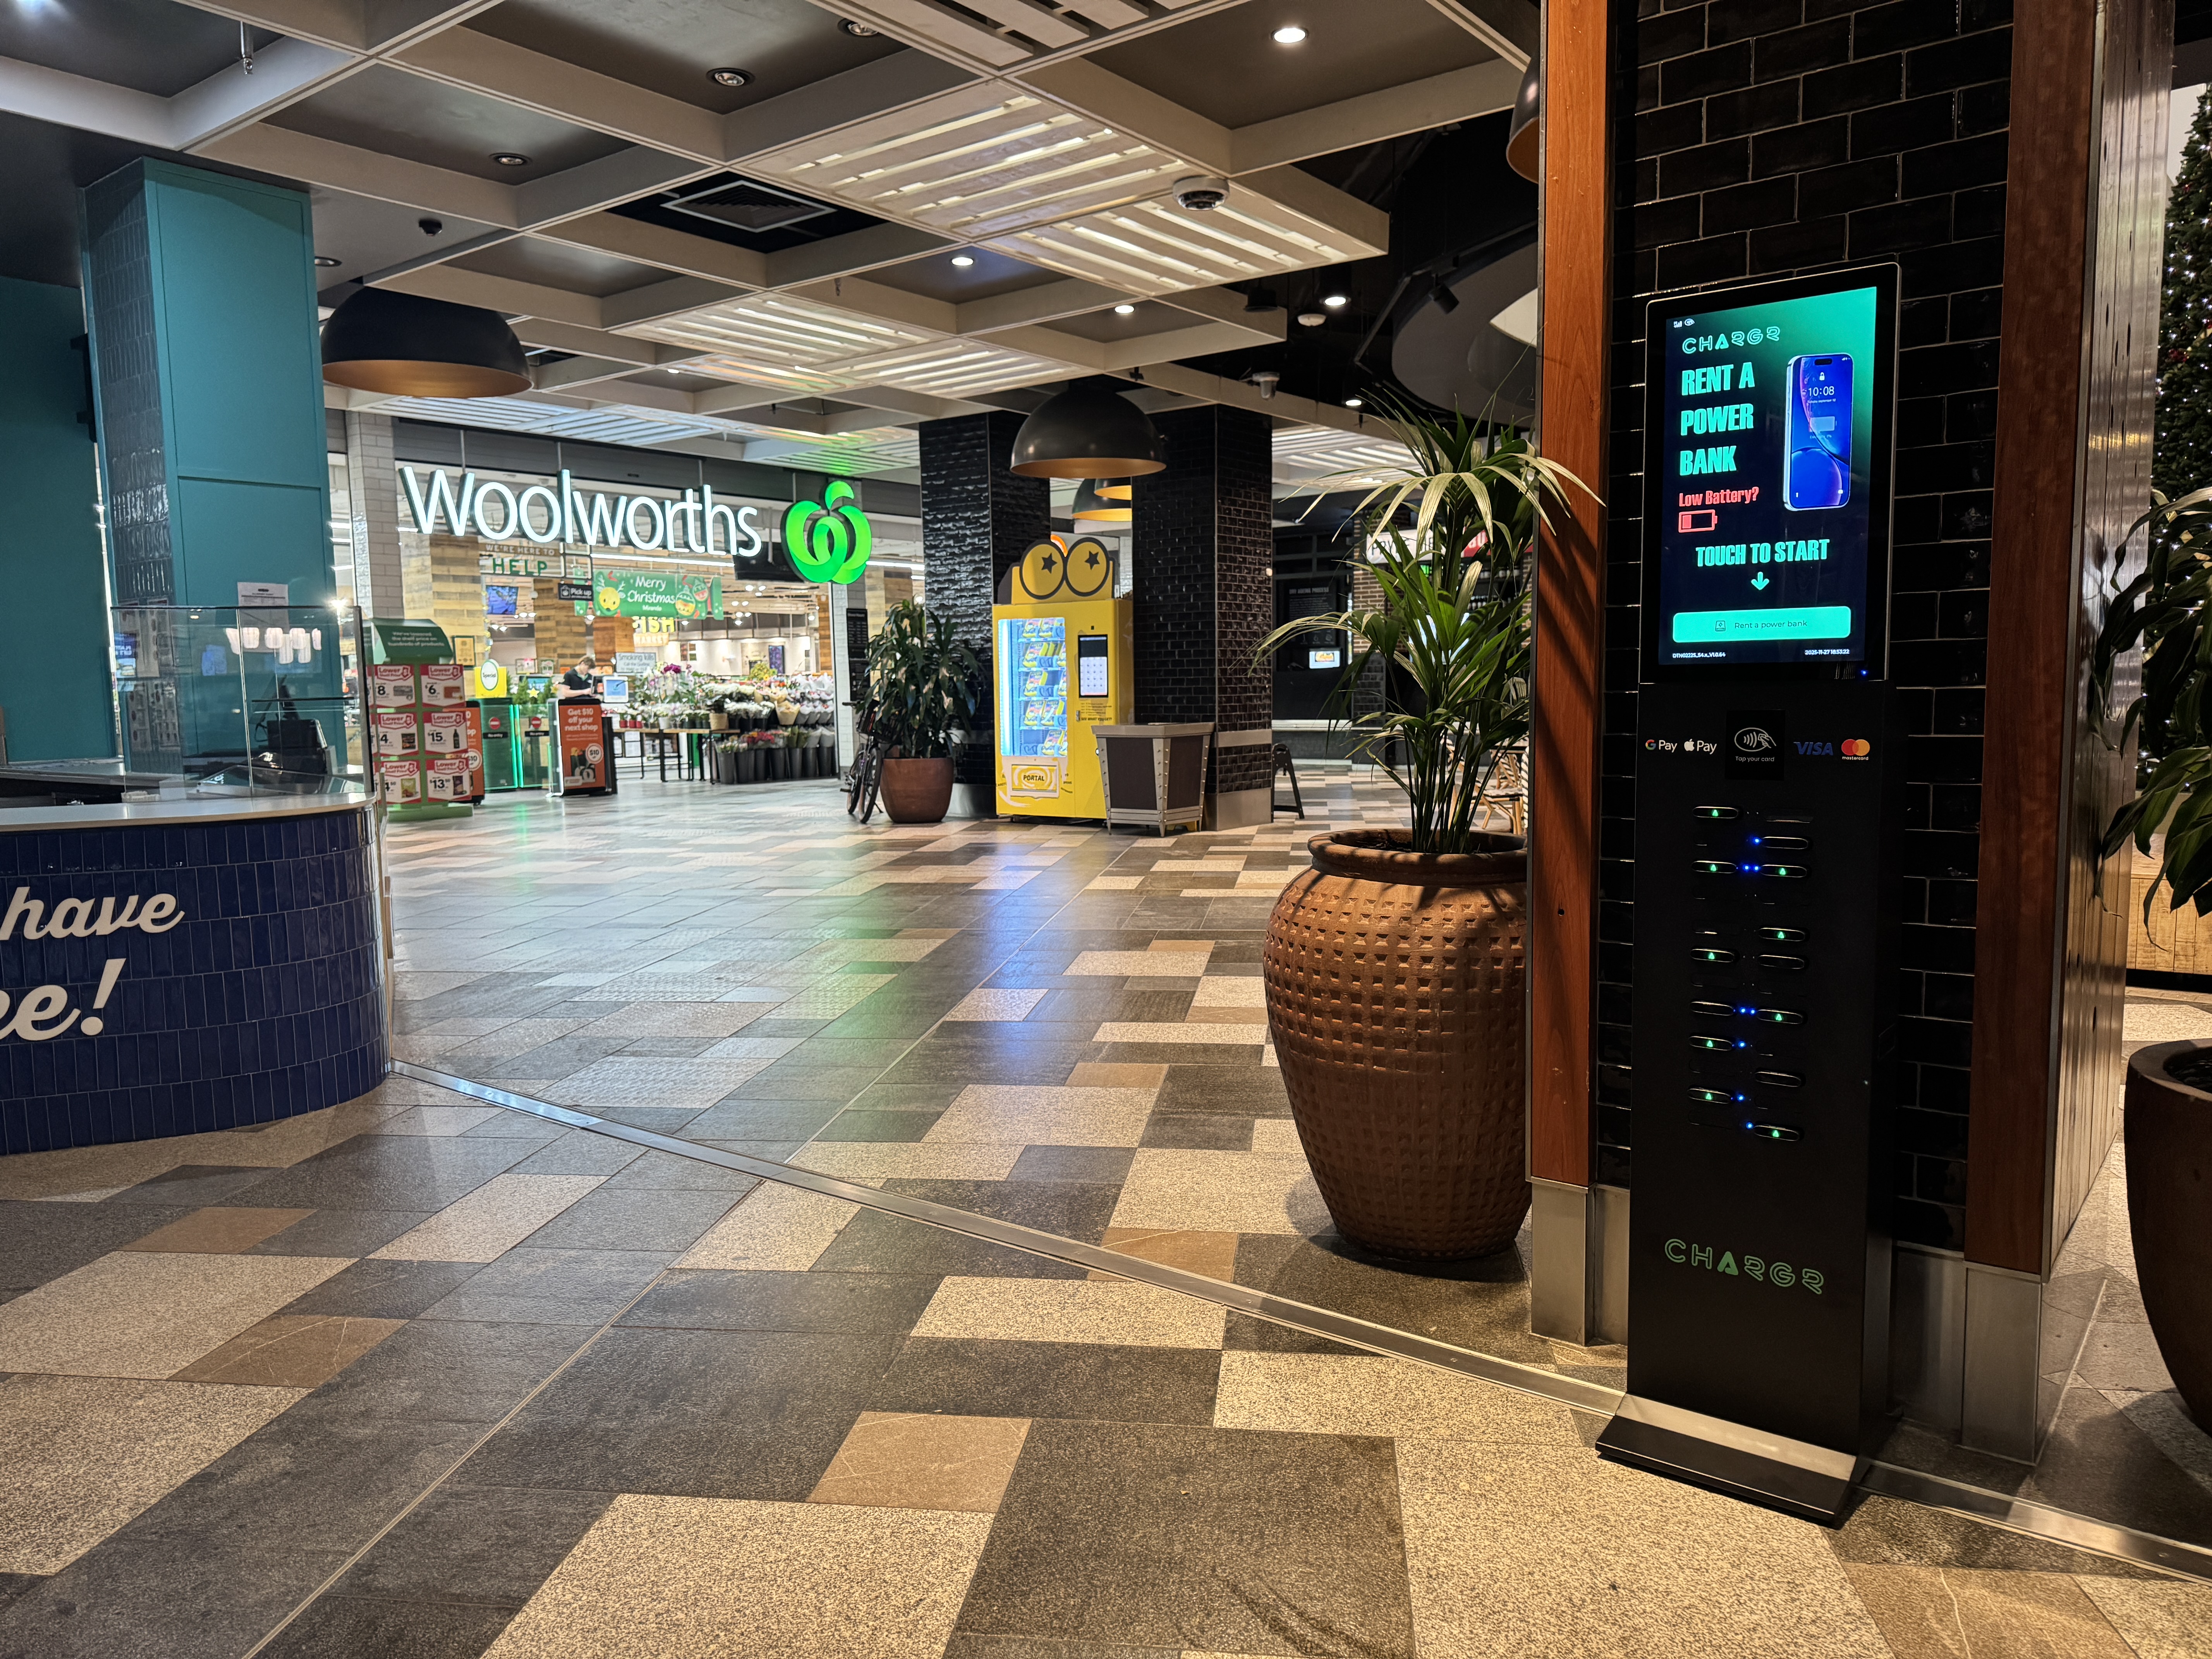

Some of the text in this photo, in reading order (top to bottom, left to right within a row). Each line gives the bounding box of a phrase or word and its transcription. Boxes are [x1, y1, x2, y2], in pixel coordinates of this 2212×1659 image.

[1682, 326, 1780, 354] CHARGR
[1682, 362, 1755, 396] RENT A
[1808, 386, 1834, 397] 10:08
[1681, 403, 1753, 436] POWER
[1680, 445, 1737, 476] BANK
[1679, 486, 1759, 507] Low Battery?
[399, 466, 762, 558] Woolworths
[486, 544, 515, 553] WE'RE
[517, 547, 540, 555] HERE
[1696, 539, 1830, 567] TOUCH TO START
[492, 557, 548, 575] HELP
[635, 576, 666, 592] Merry
[627, 590, 676, 605] Christmas
[567, 708, 594, 716] Get $10
[582, 724, 598, 732] shop
[1659, 740, 1678, 753] Pay
[1697, 740, 1717, 755] Pay
[1793, 742, 1834, 756] VISA
[0, 886, 185, 941] have
[0, 957, 127, 1041] e!
[1665, 1238, 1824, 1295] CHARGR
